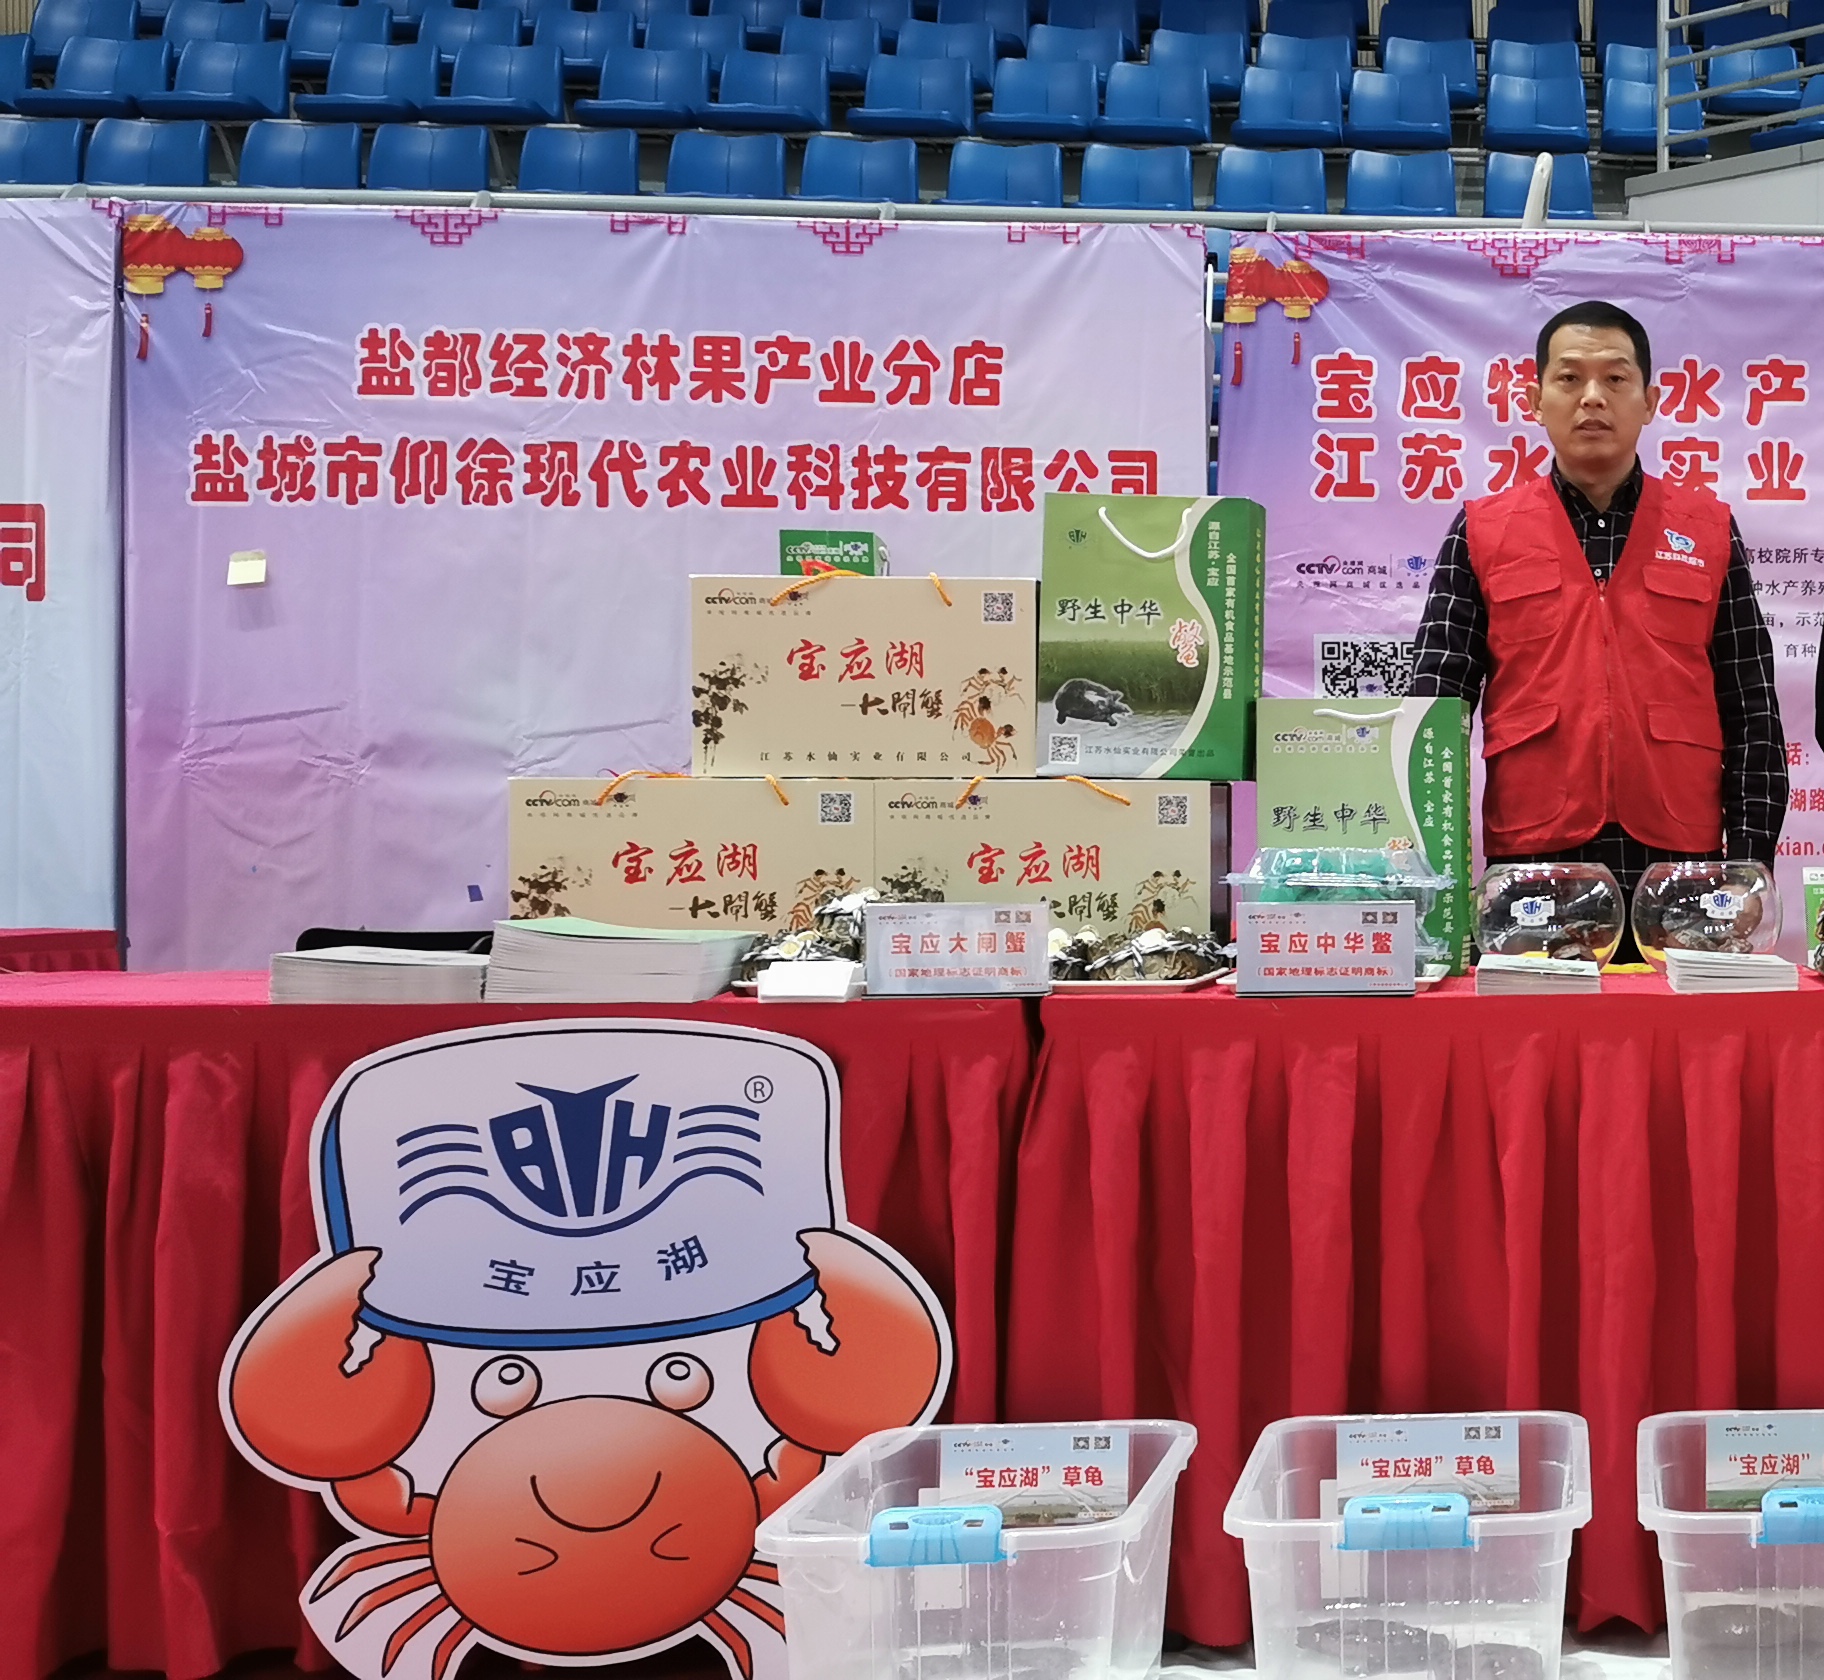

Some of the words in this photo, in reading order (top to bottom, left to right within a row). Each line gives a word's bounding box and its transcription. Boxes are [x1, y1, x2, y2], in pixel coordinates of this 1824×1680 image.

[356, 327, 1006, 406] 盐都经济林果产业分店
[189, 433, 1159, 513] 盐城市仰徐现代农业科技有限公司
[1056, 597, 1163, 627] 野生中华
[786, 637, 926, 684] 宝应湖
[1271, 802, 1391, 834] 野生中华
[611, 839, 759, 887] 宝应湖
[966, 841, 1102, 888] 宝应湖
[890, 930, 1027, 956] 宝应大闸蟹
[1259, 931, 1394, 955] 宝应中华鳖
[482, 1234, 710, 1298] 宝应湖
